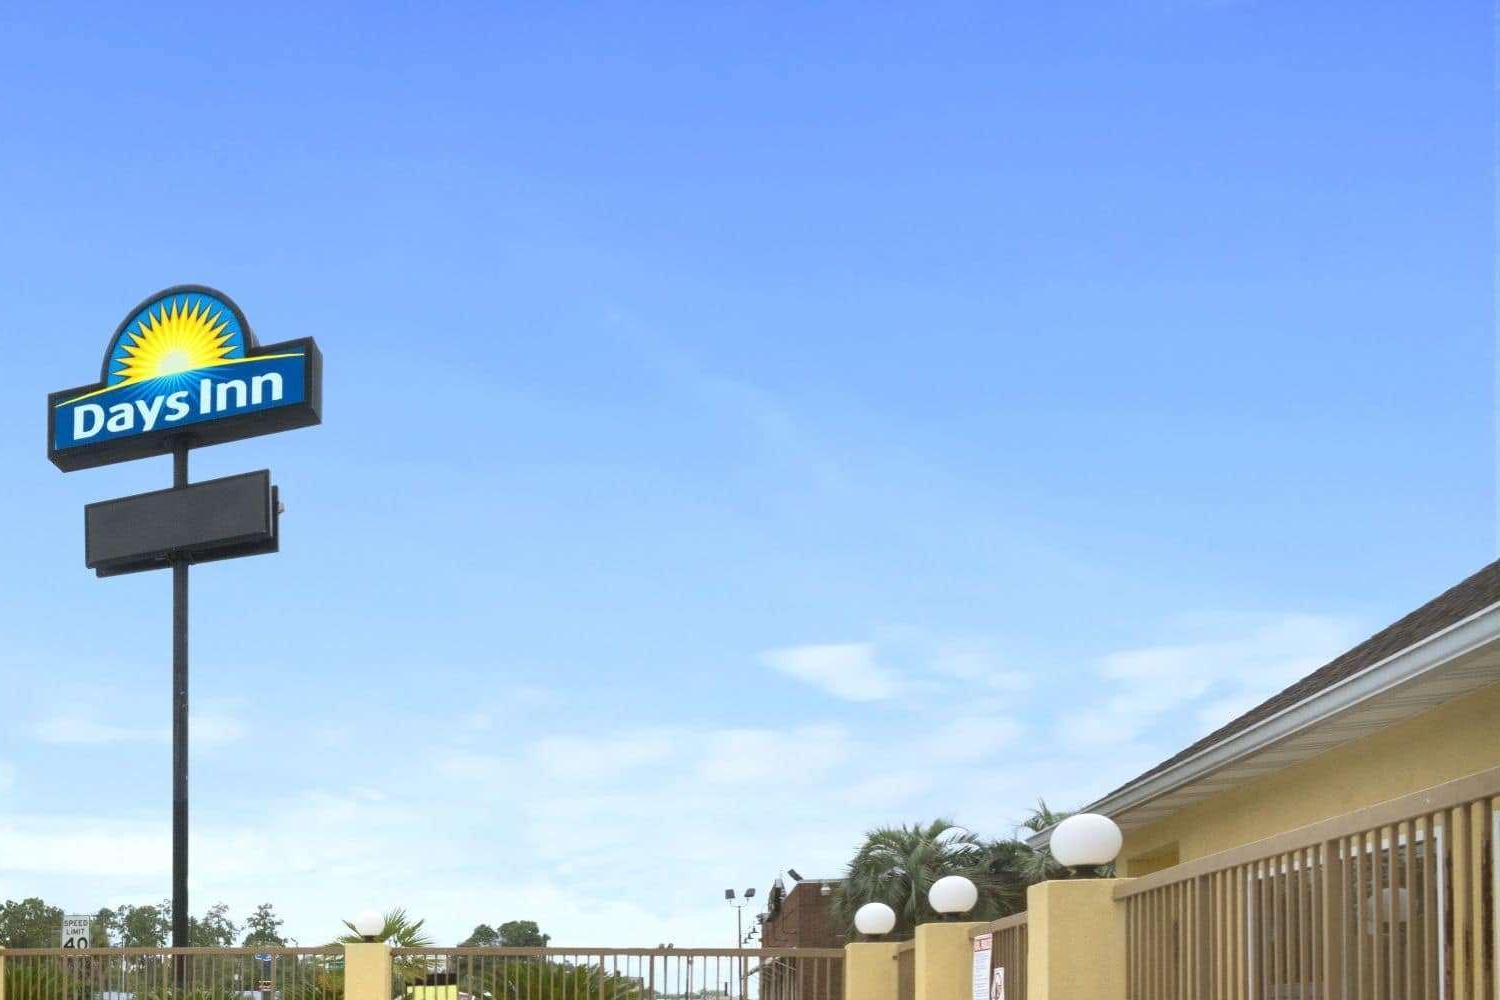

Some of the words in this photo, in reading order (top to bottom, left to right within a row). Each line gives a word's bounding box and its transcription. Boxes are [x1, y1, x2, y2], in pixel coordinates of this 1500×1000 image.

[73, 389, 190, 440] Days
[200, 371, 283, 414] Inn
[63, 936, 88, 949] 40
